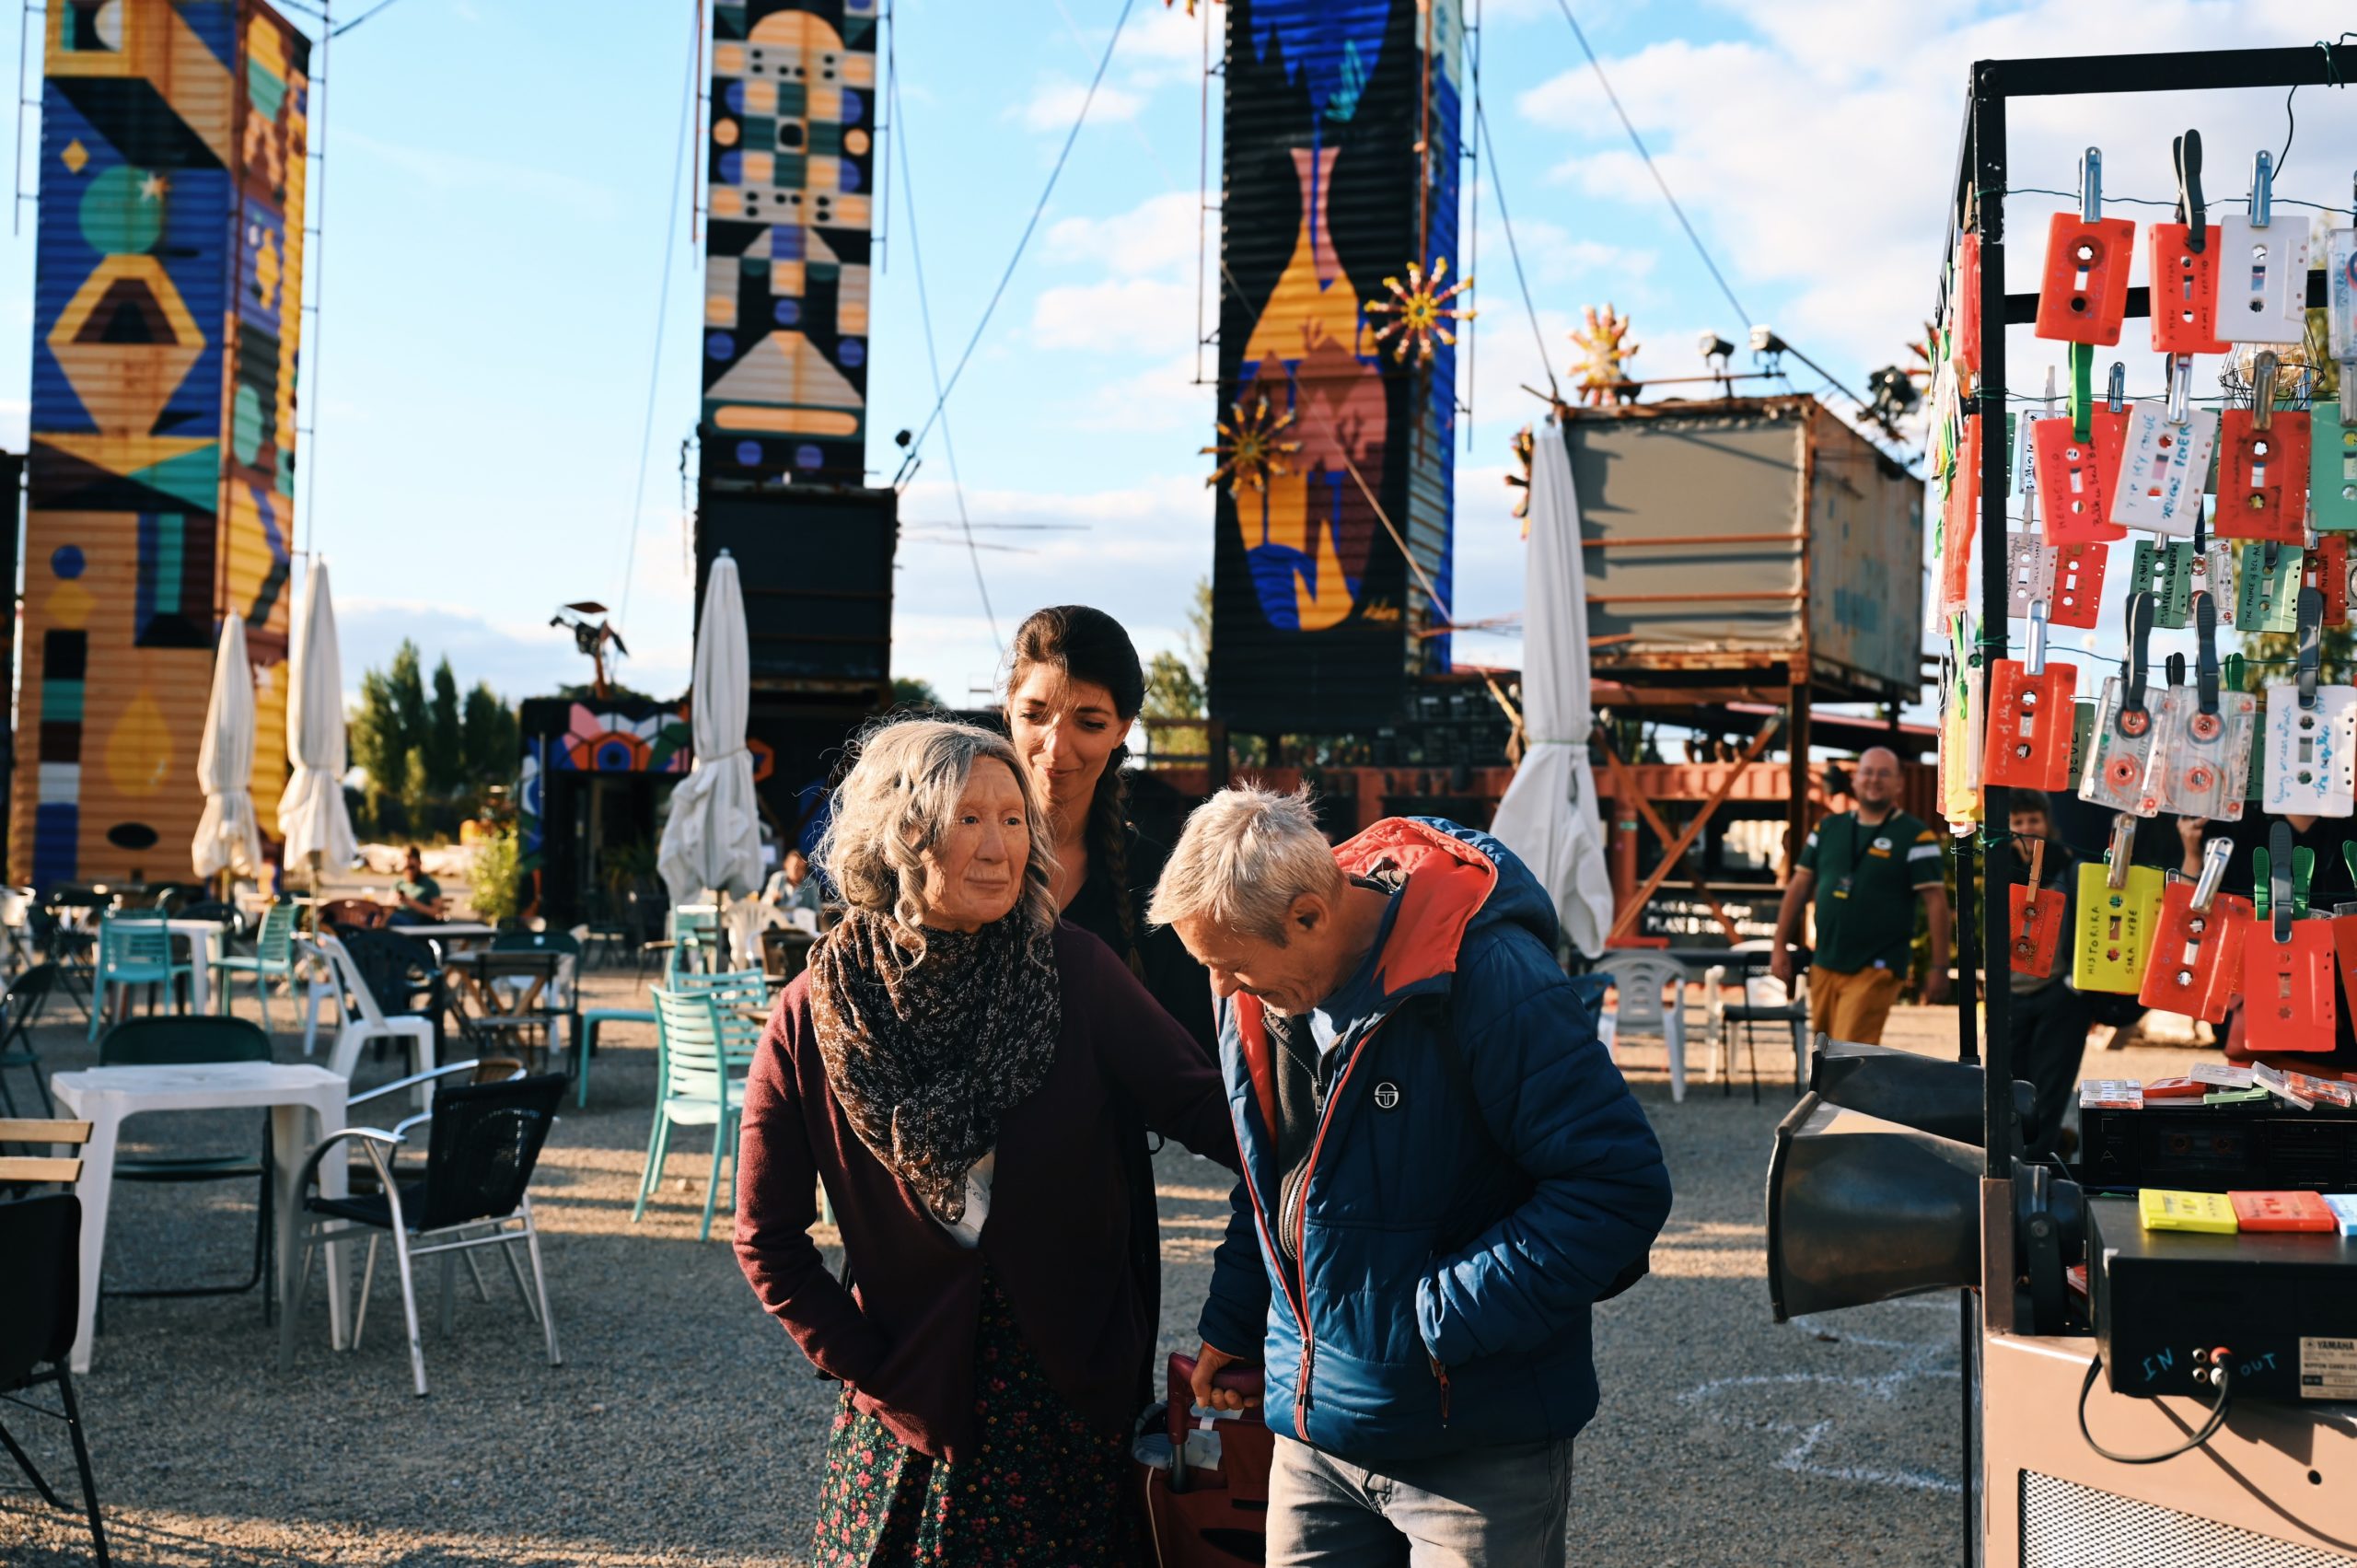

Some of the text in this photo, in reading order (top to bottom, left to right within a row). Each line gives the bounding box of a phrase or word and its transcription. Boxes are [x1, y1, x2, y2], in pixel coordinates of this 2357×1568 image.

[2246, 582, 2256, 607] PRINCE
[2244, 609, 2252, 623] THE
[1995, 703, 2011, 720] the
[1996, 724, 2013, 735] of
[2124, 908, 2138, 974] SARA HEBE
[2317, 1341, 2354, 1351] YAMAHA
[2141, 1347, 2174, 1381] IN
[2240, 1353, 2276, 1376] OUT
